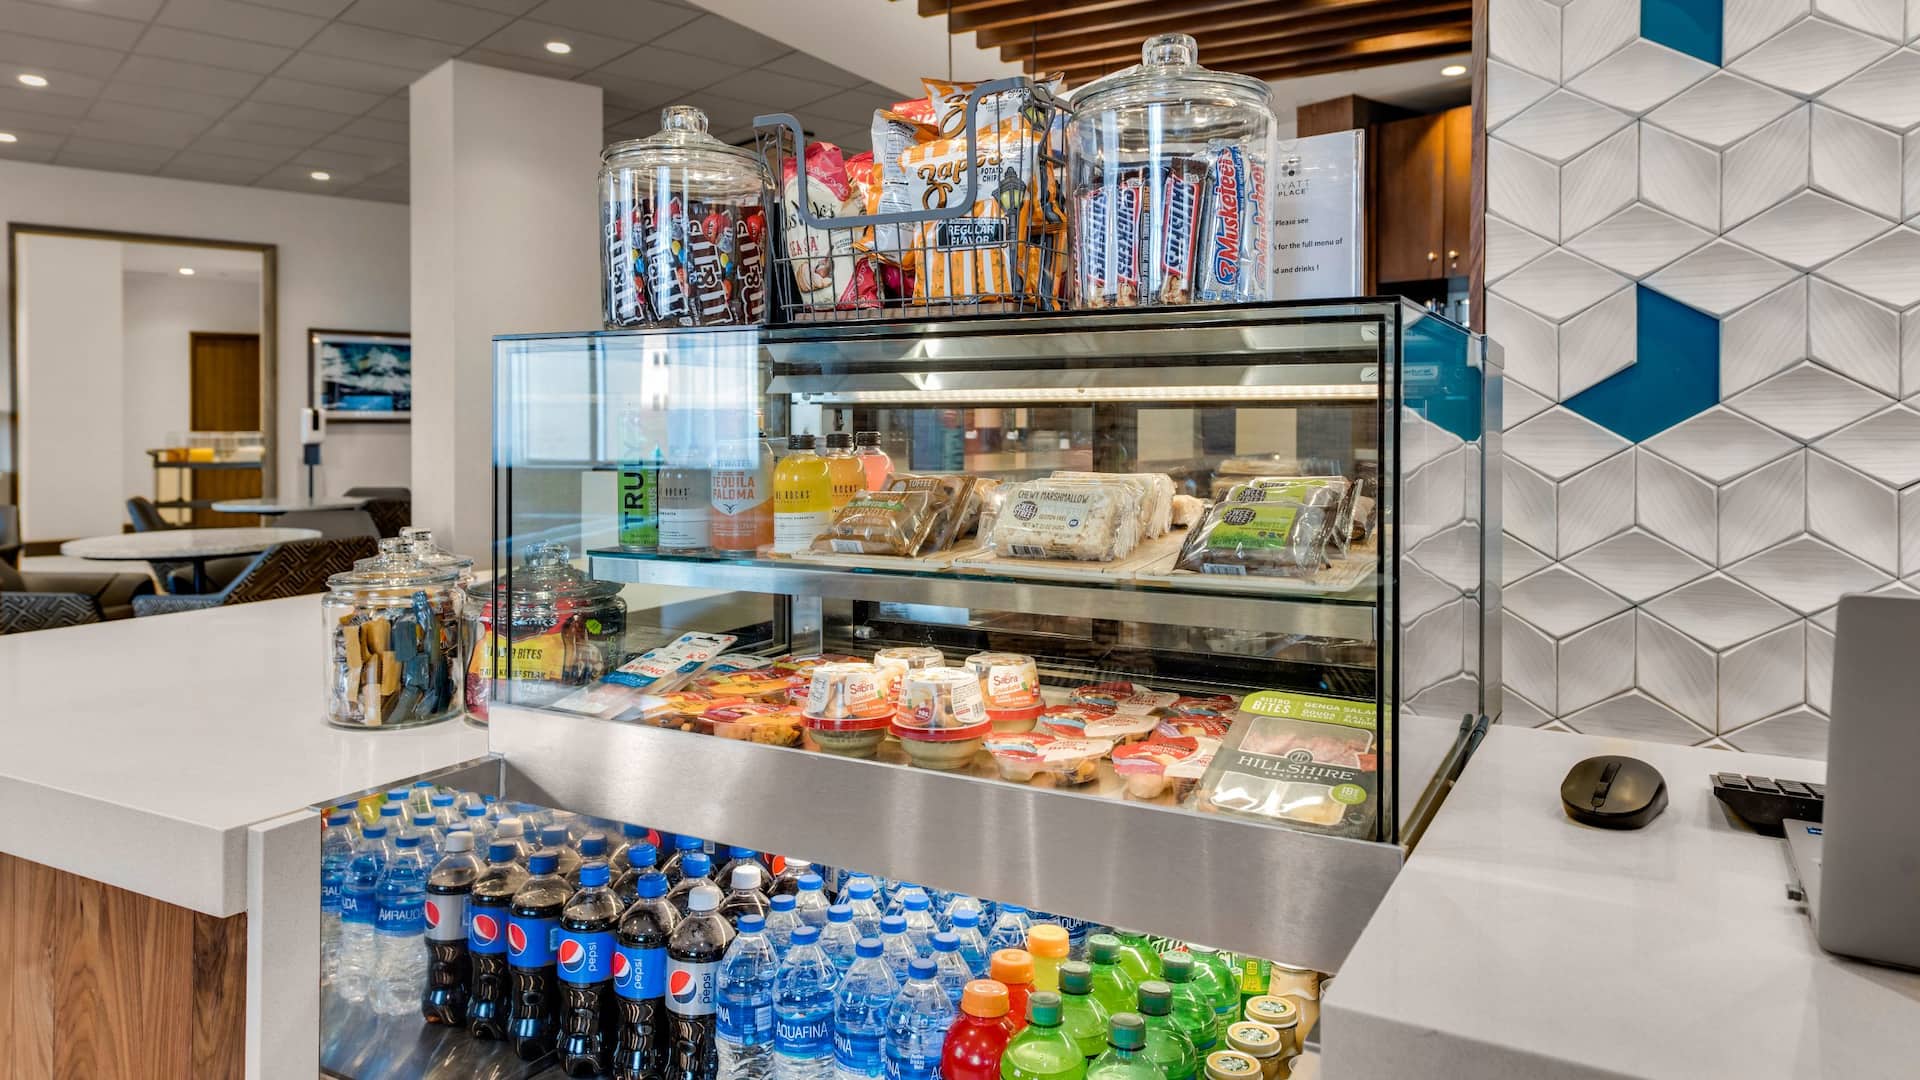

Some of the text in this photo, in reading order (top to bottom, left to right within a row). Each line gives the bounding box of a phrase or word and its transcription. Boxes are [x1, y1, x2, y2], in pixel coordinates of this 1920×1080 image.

[982, 174, 1000, 183] CHIP
[1278, 188, 1306, 198] PLACE
[1275, 218, 1296, 227] Please
[948, 225, 994, 235] REGULAR
[1117, 189, 1135, 279] SNICKERS
[951, 236, 990, 246] FLAVOR
[1289, 241, 1301, 249] the
[1302, 240, 1313, 248] full
[1314, 239, 1334, 247] menu
[1335, 237, 1343, 245] of
[1280, 265, 1293, 274] and
[1294, 264, 1315, 273] drinks
[712, 476, 755, 488] TEQUILA
[624, 457, 645, 530] TRUL
[712, 488, 755, 500] PALOMA
[1018, 490, 1090, 505] CHEWY MARSHMALLOW
[518, 648, 543, 660] BITES
[993, 673, 1018, 686] Sabra
[850, 681, 874, 695] Sabra
[1303, 701, 1377, 715] GENOA SALA
[1237, 755, 1356, 781] HILLSHIRE
[587, 942, 599, 972] pepsi
[633, 958, 645, 990] pepsi
[702, 973, 713, 1004] pepsi
[776, 1020, 830, 1041] AQUAFINA
